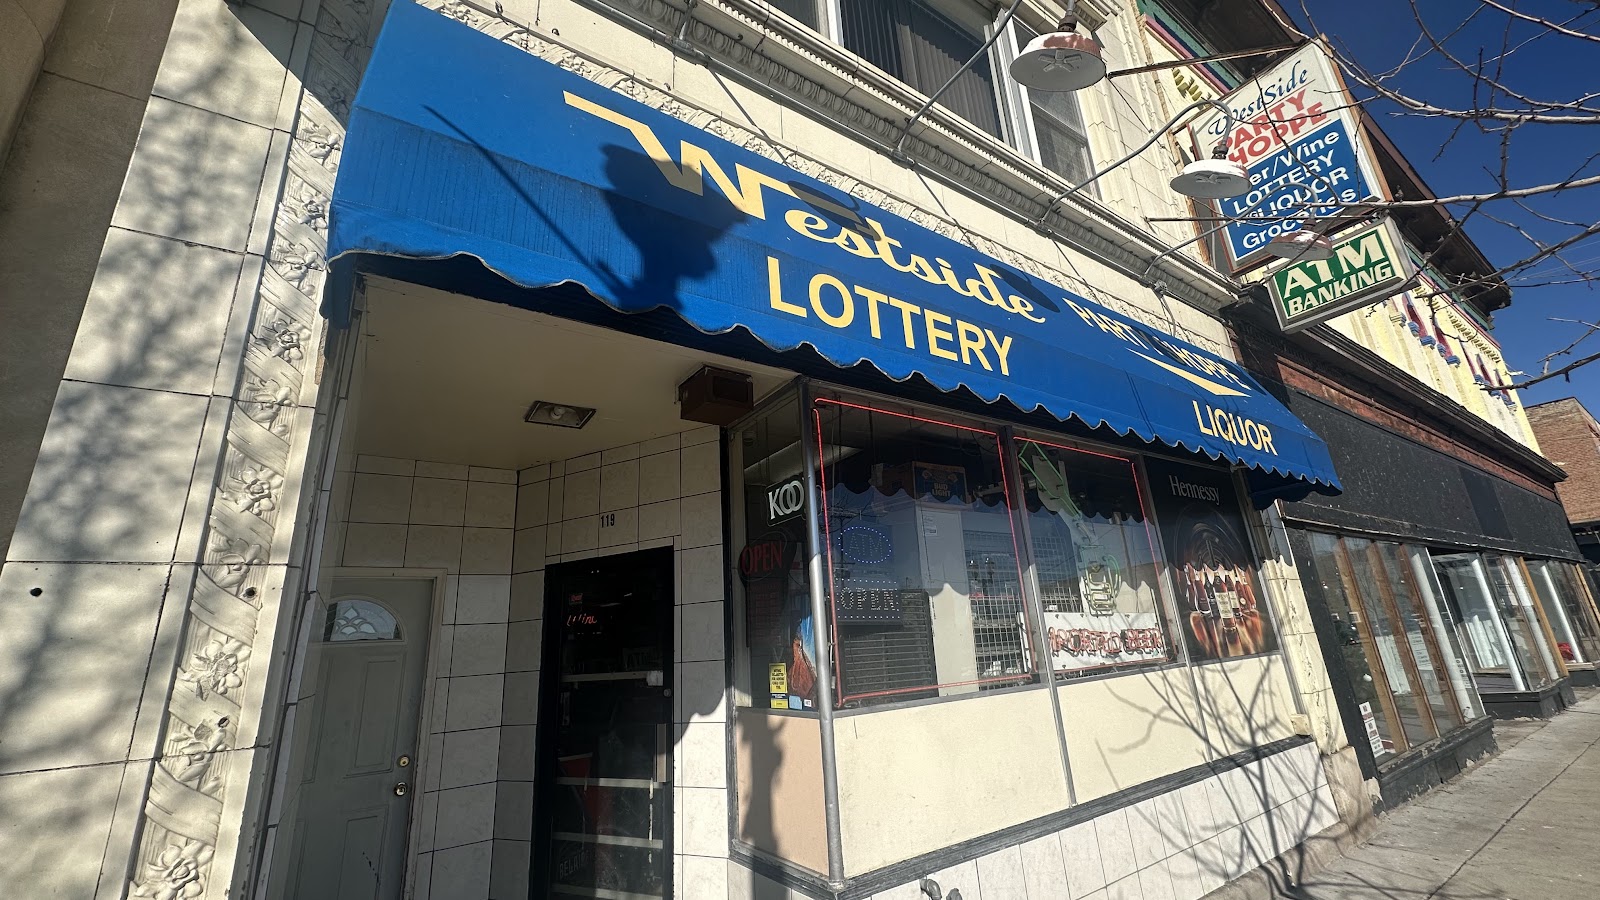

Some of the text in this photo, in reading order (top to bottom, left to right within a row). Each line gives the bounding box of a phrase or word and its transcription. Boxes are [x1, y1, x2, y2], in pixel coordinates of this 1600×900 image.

[1227, 101, 1328, 166] HOPPE
[1248, 131, 1340, 186] er/Wine
[563, 89, 1046, 324] Westside
[1232, 149, 1335, 215] LOTTERY
[1242, 188, 1357, 249] Groceies
[1283, 233, 1386, 299] ATM
[1287, 260, 1393, 316] BANKING
[767, 255, 1013, 377] LOTTERY
[1192, 400, 1279, 456] LIQUOR
[768, 480, 805, 520] KOO
[1168, 474, 1220, 506] Hennessy
[600, 513, 615, 528] 119
[741, 541, 784, 576] OPEN
[841, 586, 896, 611] OPEN
